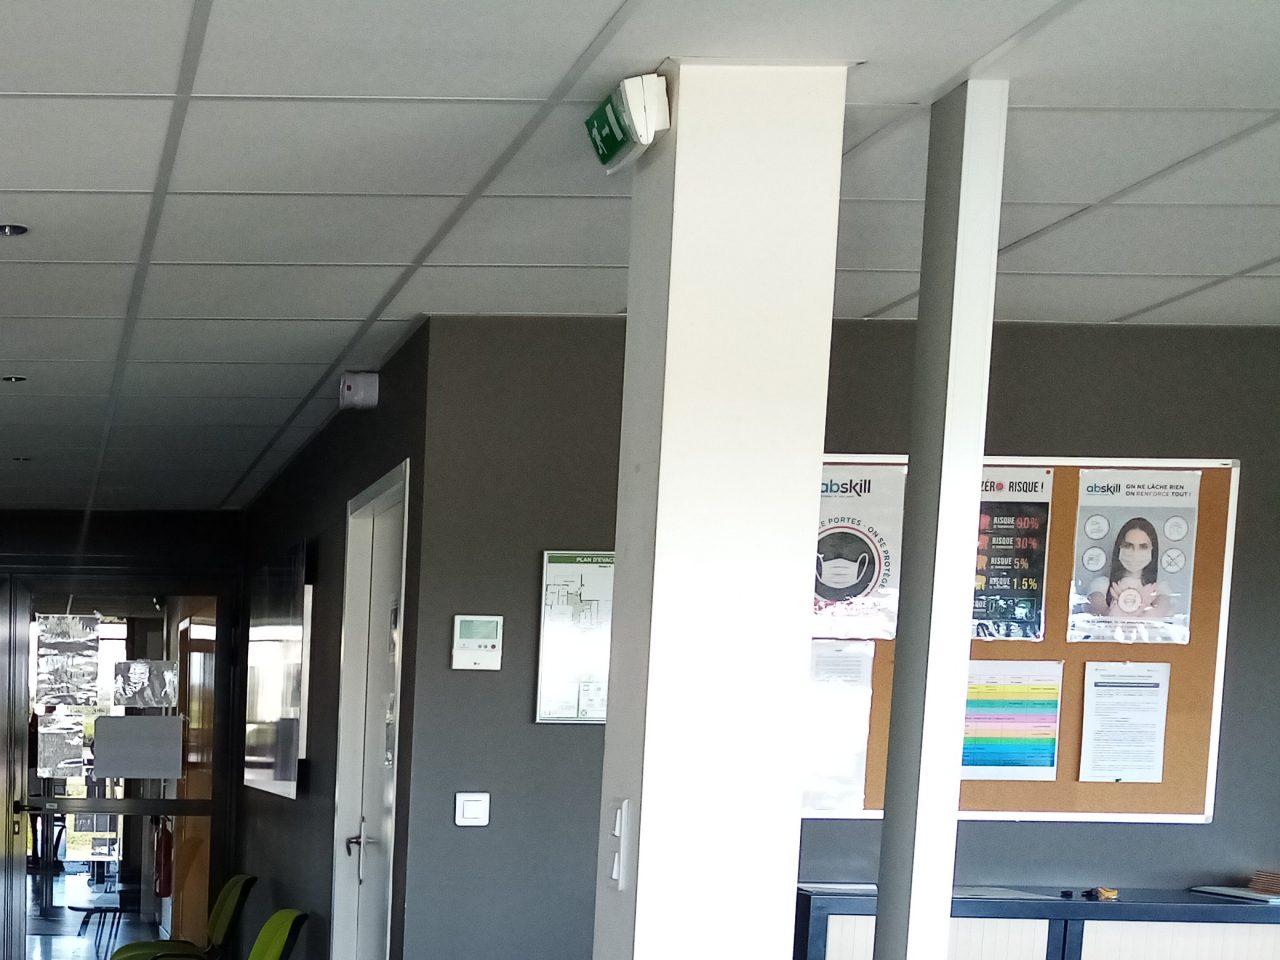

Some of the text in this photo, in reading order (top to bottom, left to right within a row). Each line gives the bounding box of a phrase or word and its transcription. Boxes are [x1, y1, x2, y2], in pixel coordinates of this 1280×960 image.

[821, 479, 871, 497] abskill
[1008, 481, 1039, 493] RISQUE
[1086, 483, 1121, 495] abskill
[993, 516, 1015, 525] RISQUE
[828, 516, 861, 527] PORTES
[867, 526, 880, 538] ON
[877, 537, 888, 549] SE
[992, 537, 1038, 549] RISQUE 30%
[990, 557, 1029, 569] RISQUE 5%
[1012, 577, 1038, 590] 1.5%
